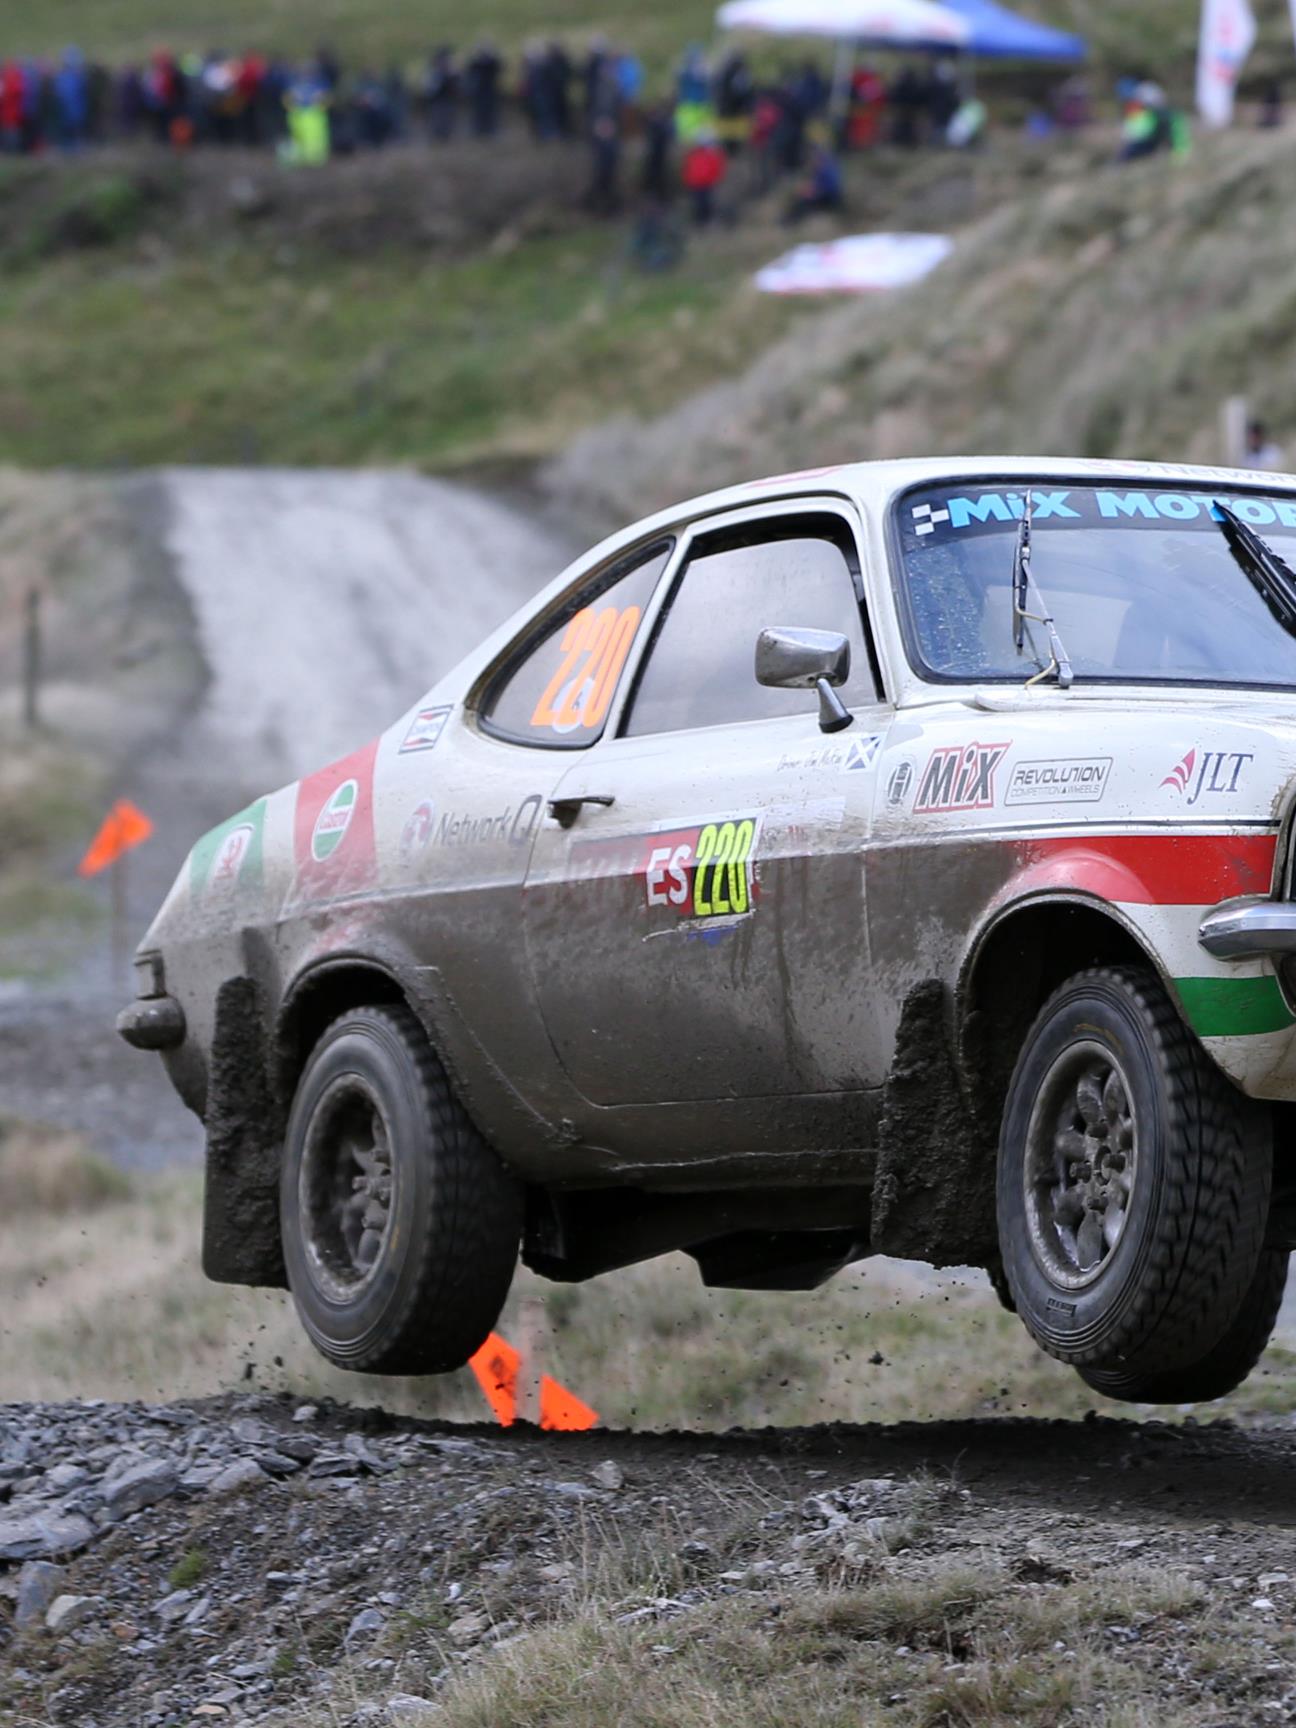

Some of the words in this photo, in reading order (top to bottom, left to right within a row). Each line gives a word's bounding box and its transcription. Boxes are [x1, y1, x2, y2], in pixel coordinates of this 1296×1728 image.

[948, 490, 1081, 528] MiX
[530, 606, 640, 728] 220
[919, 749, 1002, 807] MiX
[1013, 766, 1106, 786] REVOLUTION
[1066, 783, 1101, 794] WHEELS
[1187, 752, 1253, 804] JLT
[434, 806, 512, 846] Network
[646, 844, 692, 906] ES
[693, 820, 753, 916] 220
